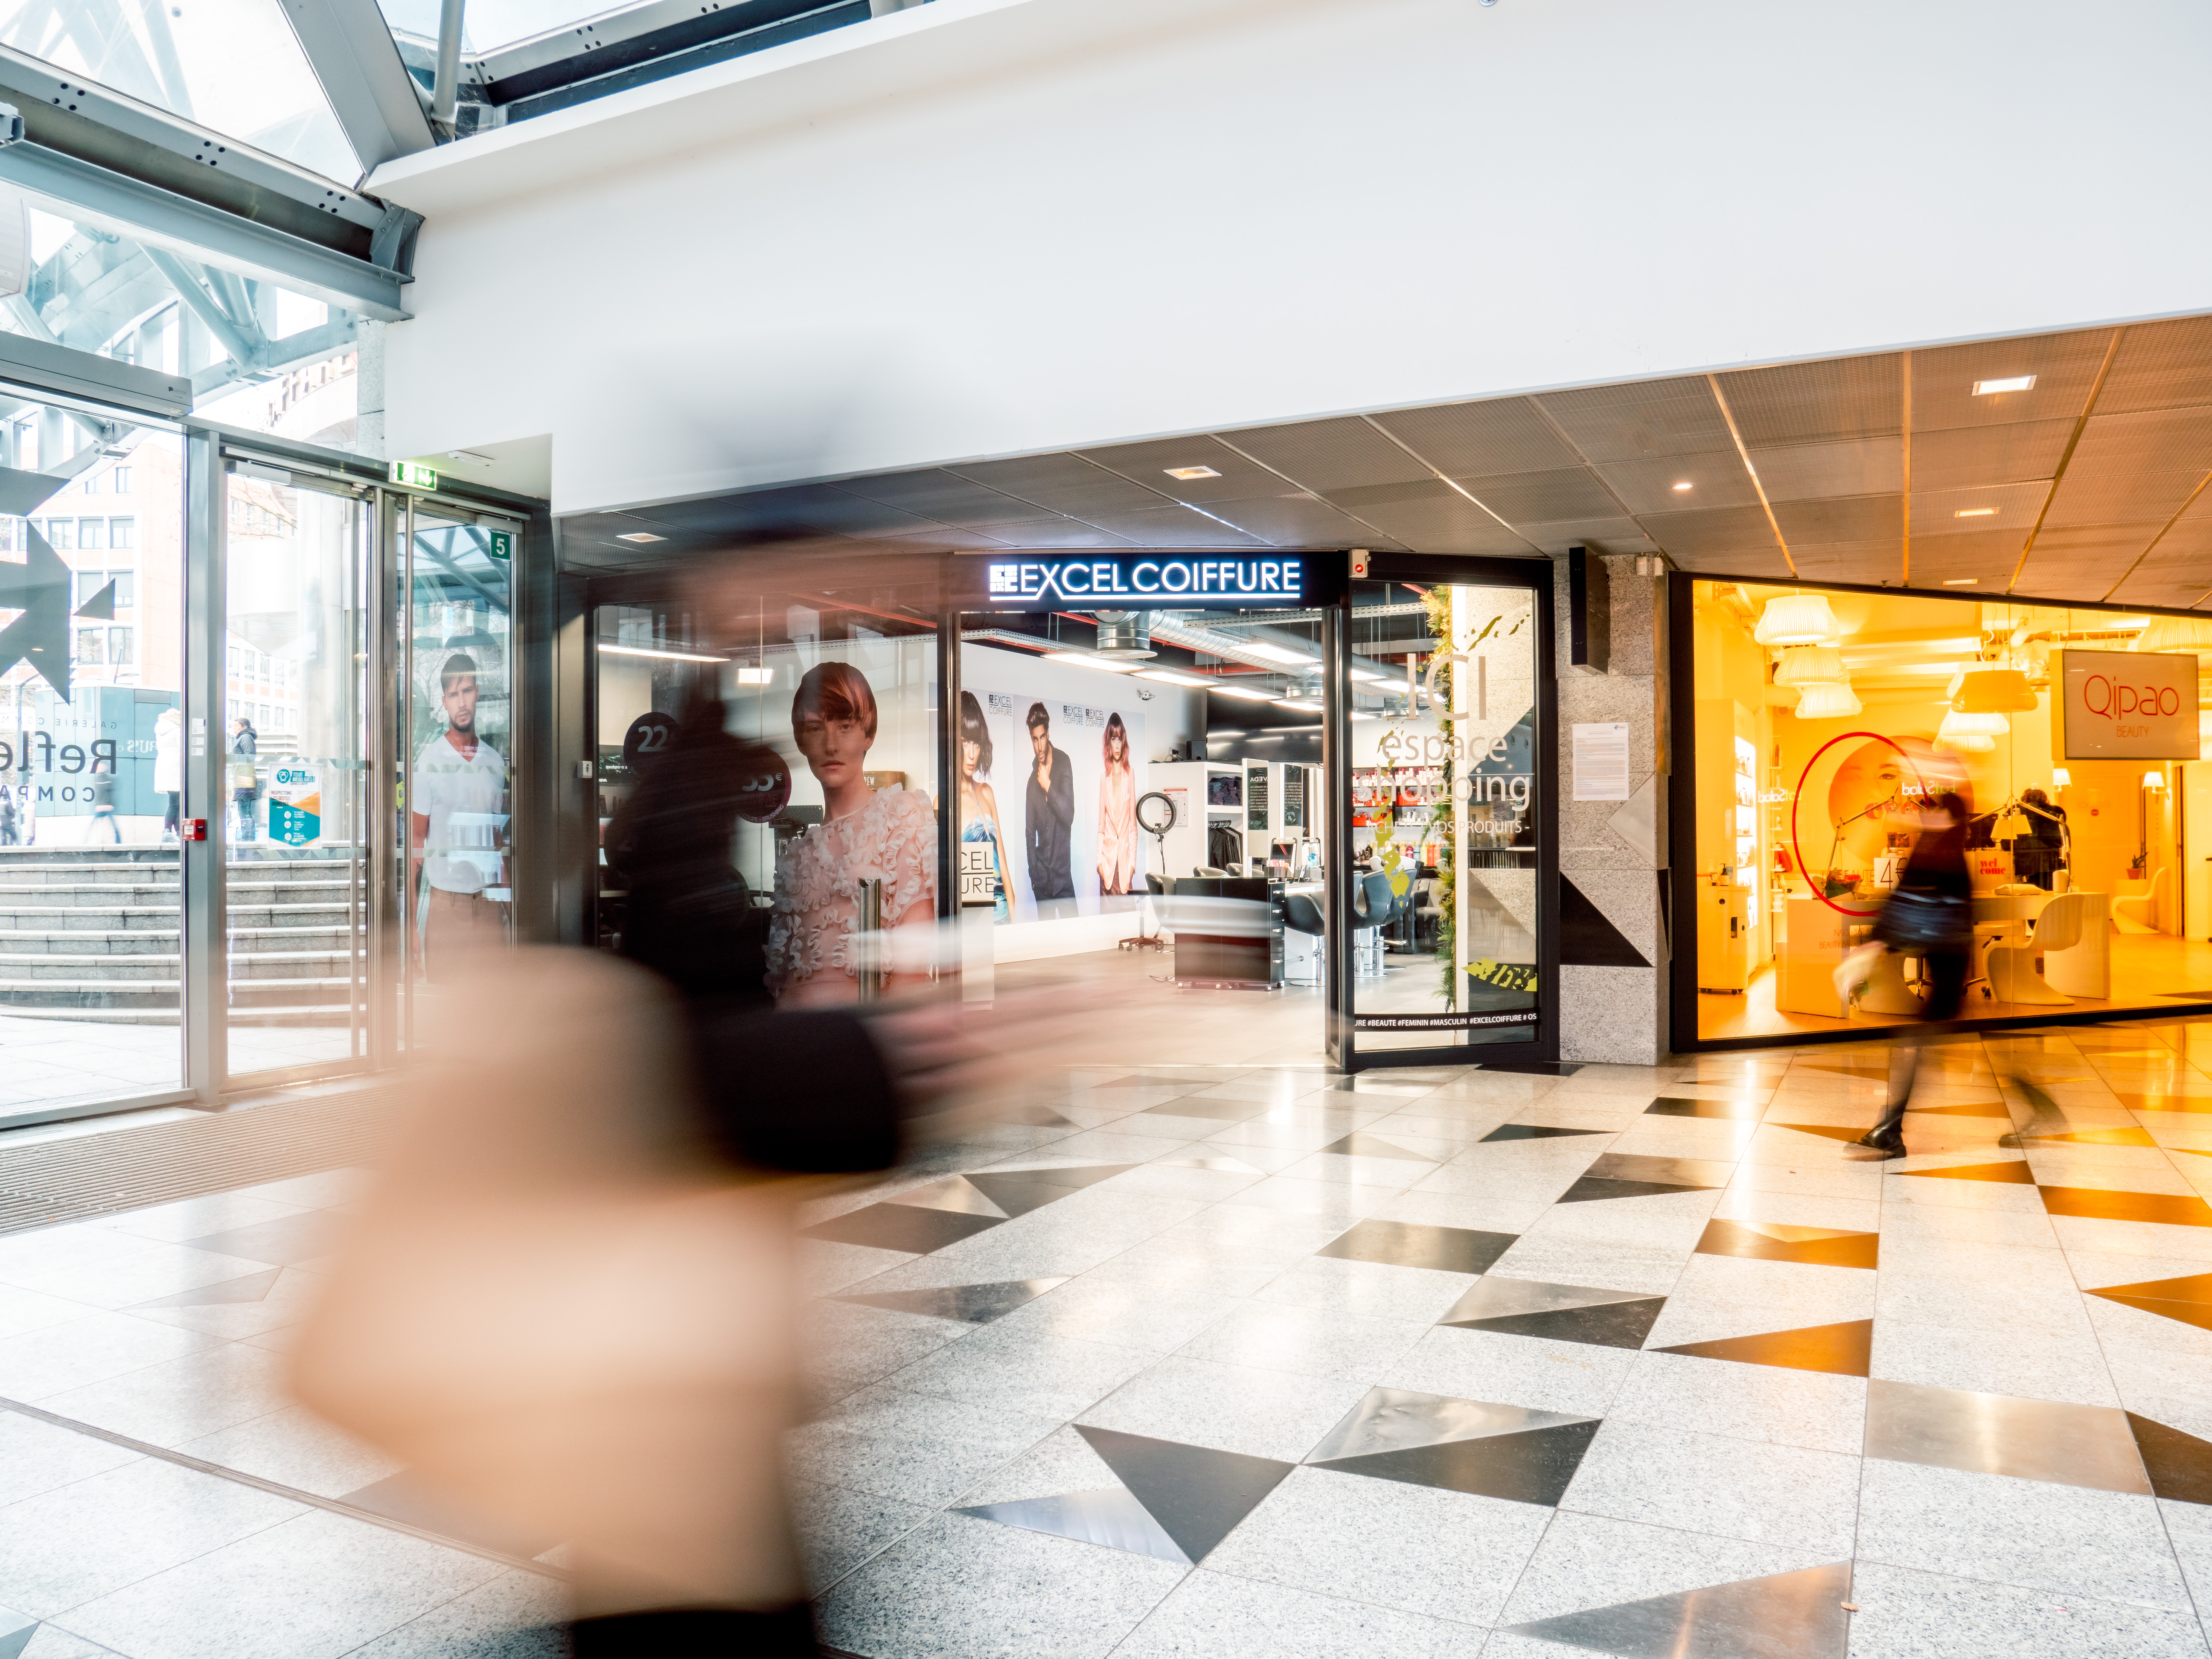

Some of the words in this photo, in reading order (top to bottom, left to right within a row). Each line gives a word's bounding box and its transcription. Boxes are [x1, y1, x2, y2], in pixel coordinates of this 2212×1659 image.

[496, 538, 506, 555] 5
[1021, 563, 1129, 600] EXCEL
[1132, 562, 1300, 592] COIFFURE
[1407, 653, 1487, 720] ICI
[994, 695, 1012, 707] EXCEL
[2084, 675, 2179, 720] Qipao
[989, 706, 1013, 716] COIFFURE
[1068, 706, 1083, 716] EXCEL
[1090, 709, 1104, 719] EXCEL
[1063, 716, 1083, 725] COIFFURE
[1086, 719, 1105, 728] COIFFURE
[2116, 725, 2149, 737] BEAUTY
[1382, 734, 1508, 769] espace
[1357, 765, 1530, 811] shopping
[1458, 821, 1522, 833] PRODUITS
[1429, 1018, 1467, 1026] #MASCULIN
[1470, 1014, 1522, 1024] #EXCELCOIFFURE
